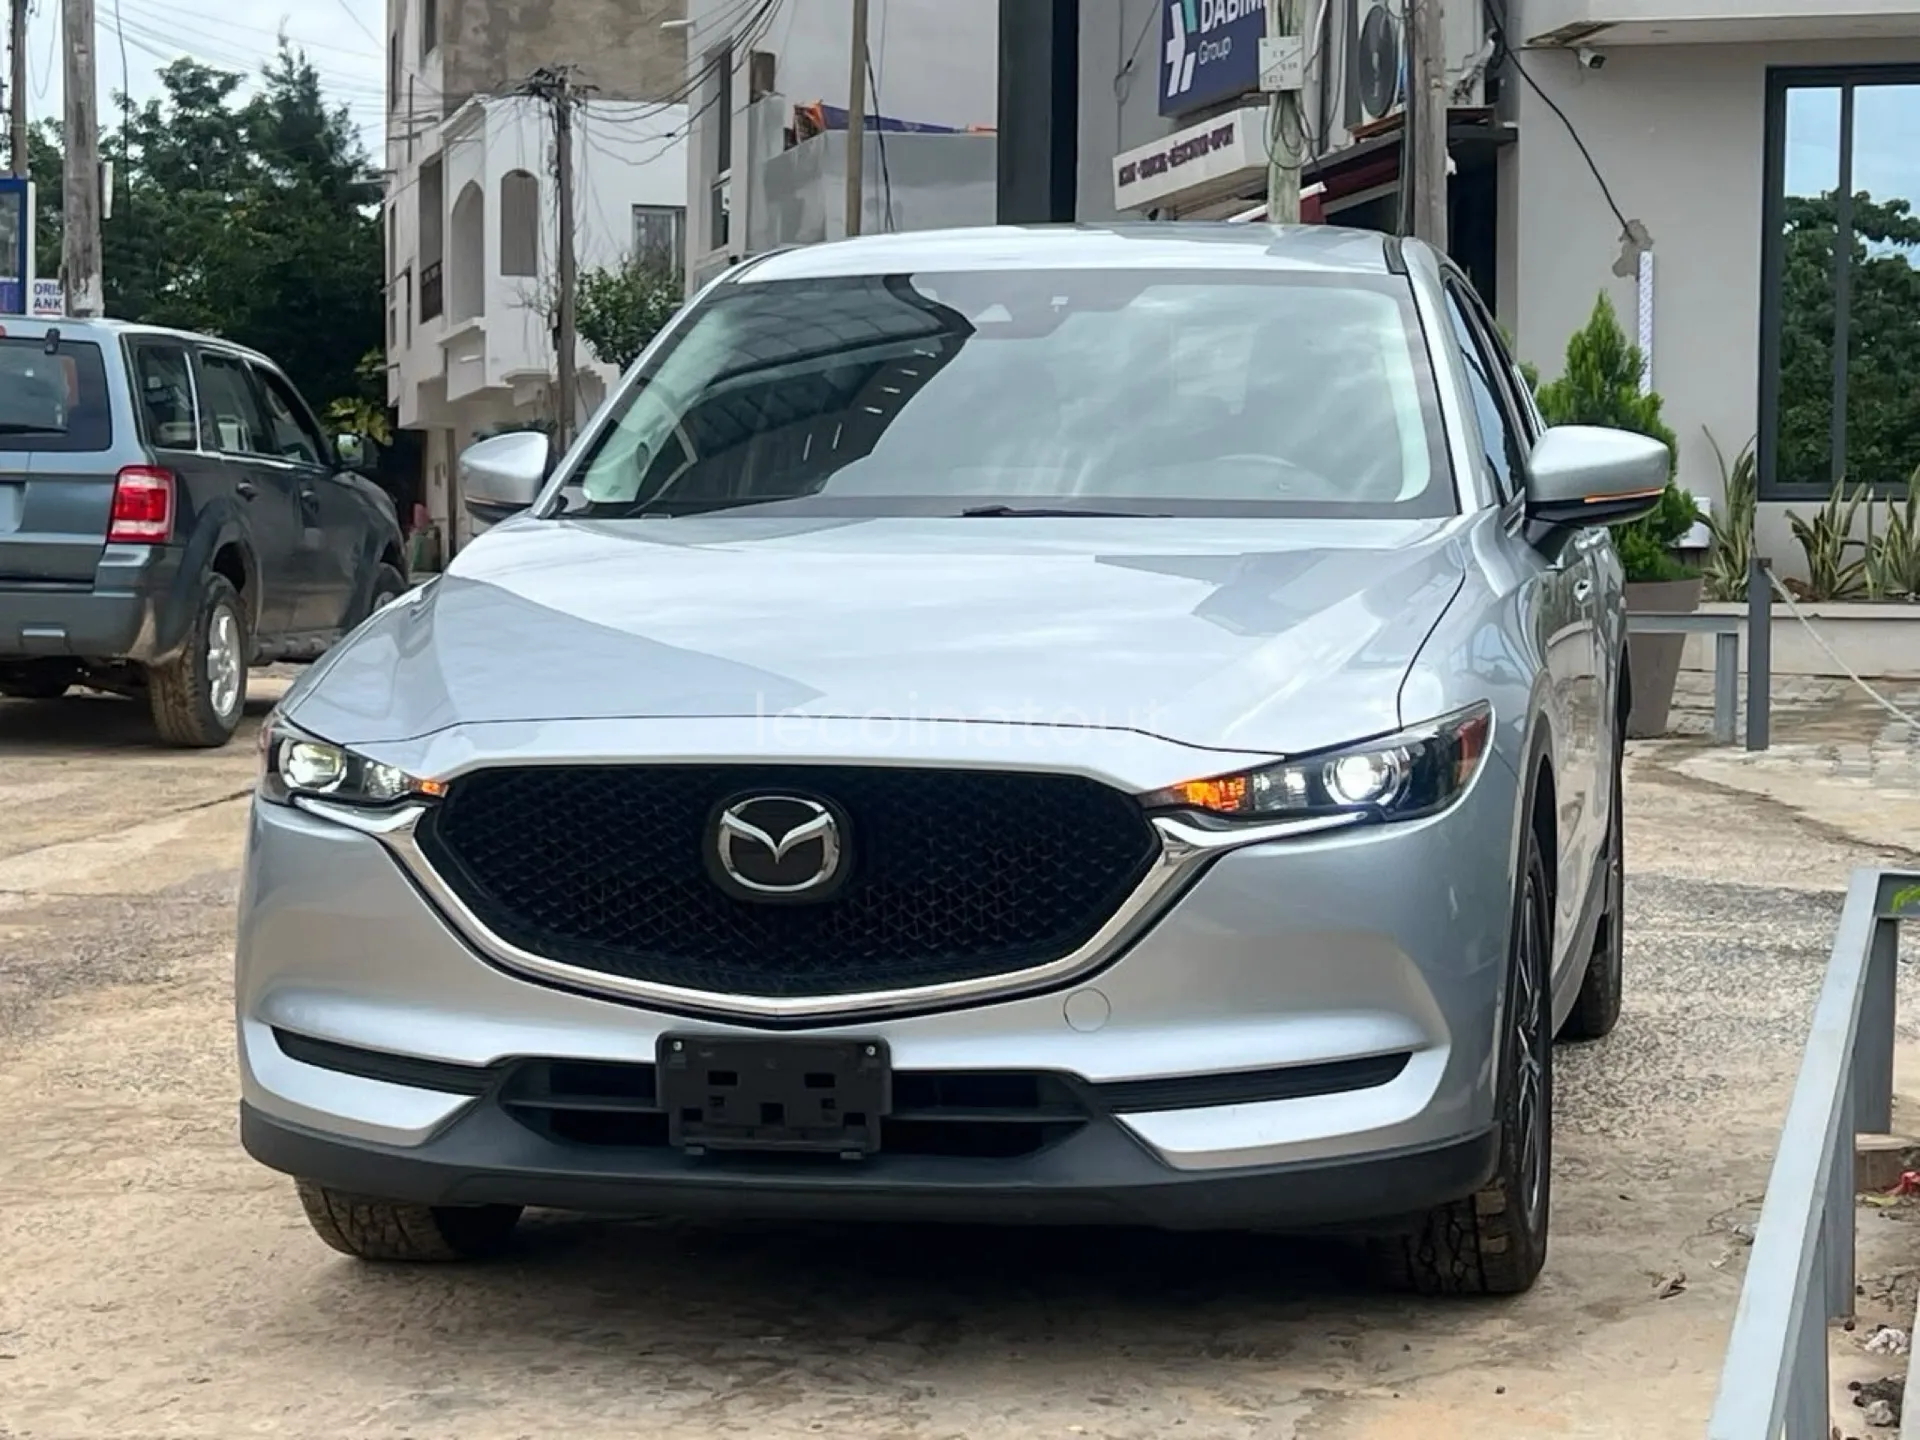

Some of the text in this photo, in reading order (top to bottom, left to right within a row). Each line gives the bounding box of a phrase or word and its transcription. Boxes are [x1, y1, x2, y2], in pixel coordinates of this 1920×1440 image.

[1200, 0, 1267, 34] DABI
[1198, 36, 1233, 66] Group
[34, 283, 63, 295] ORIS
[34, 297, 62, 309] ANK
